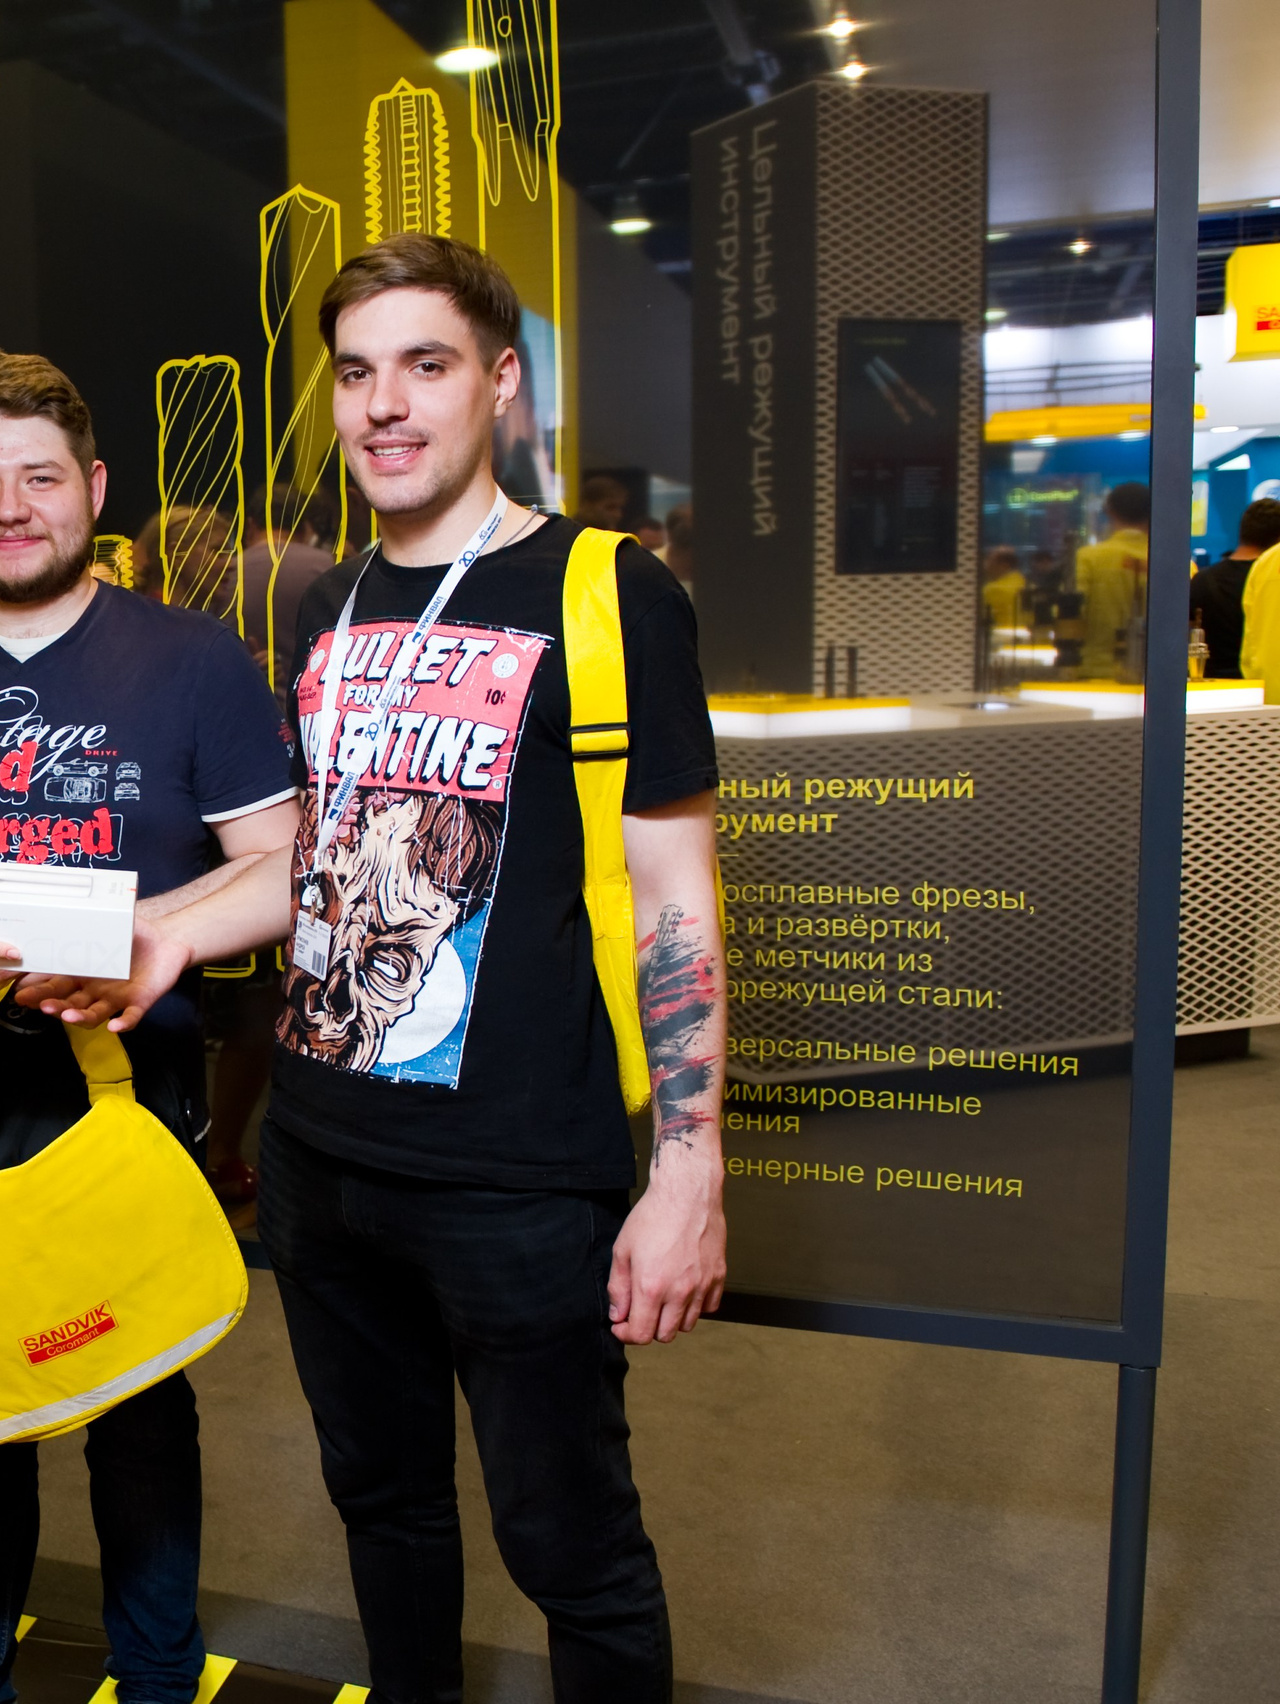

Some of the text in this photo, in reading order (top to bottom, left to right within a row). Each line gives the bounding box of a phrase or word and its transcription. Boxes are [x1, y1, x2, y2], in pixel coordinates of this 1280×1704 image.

[333, 771, 356, 807] ФИНВАЛ
[718, 771, 975, 805] ный режущий
[723, 881, 1037, 915] осплавные фрезы,
[748, 916, 765, 935] и
[776, 913, 952, 945] развёртки,
[754, 947, 886, 971] метчики
[897, 952, 934, 973] из
[726, 977, 1005, 1010] орежущей стали:
[726, 1036, 1080, 1077] версальные решения
[723, 1081, 983, 1117] имизированные
[721, 1110, 801, 1135] ения
[722, 1153, 1024, 1199] енерные решения
[22, 1303, 112, 1353] SANDVIK
[45, 1327, 101, 1357] Coromant
